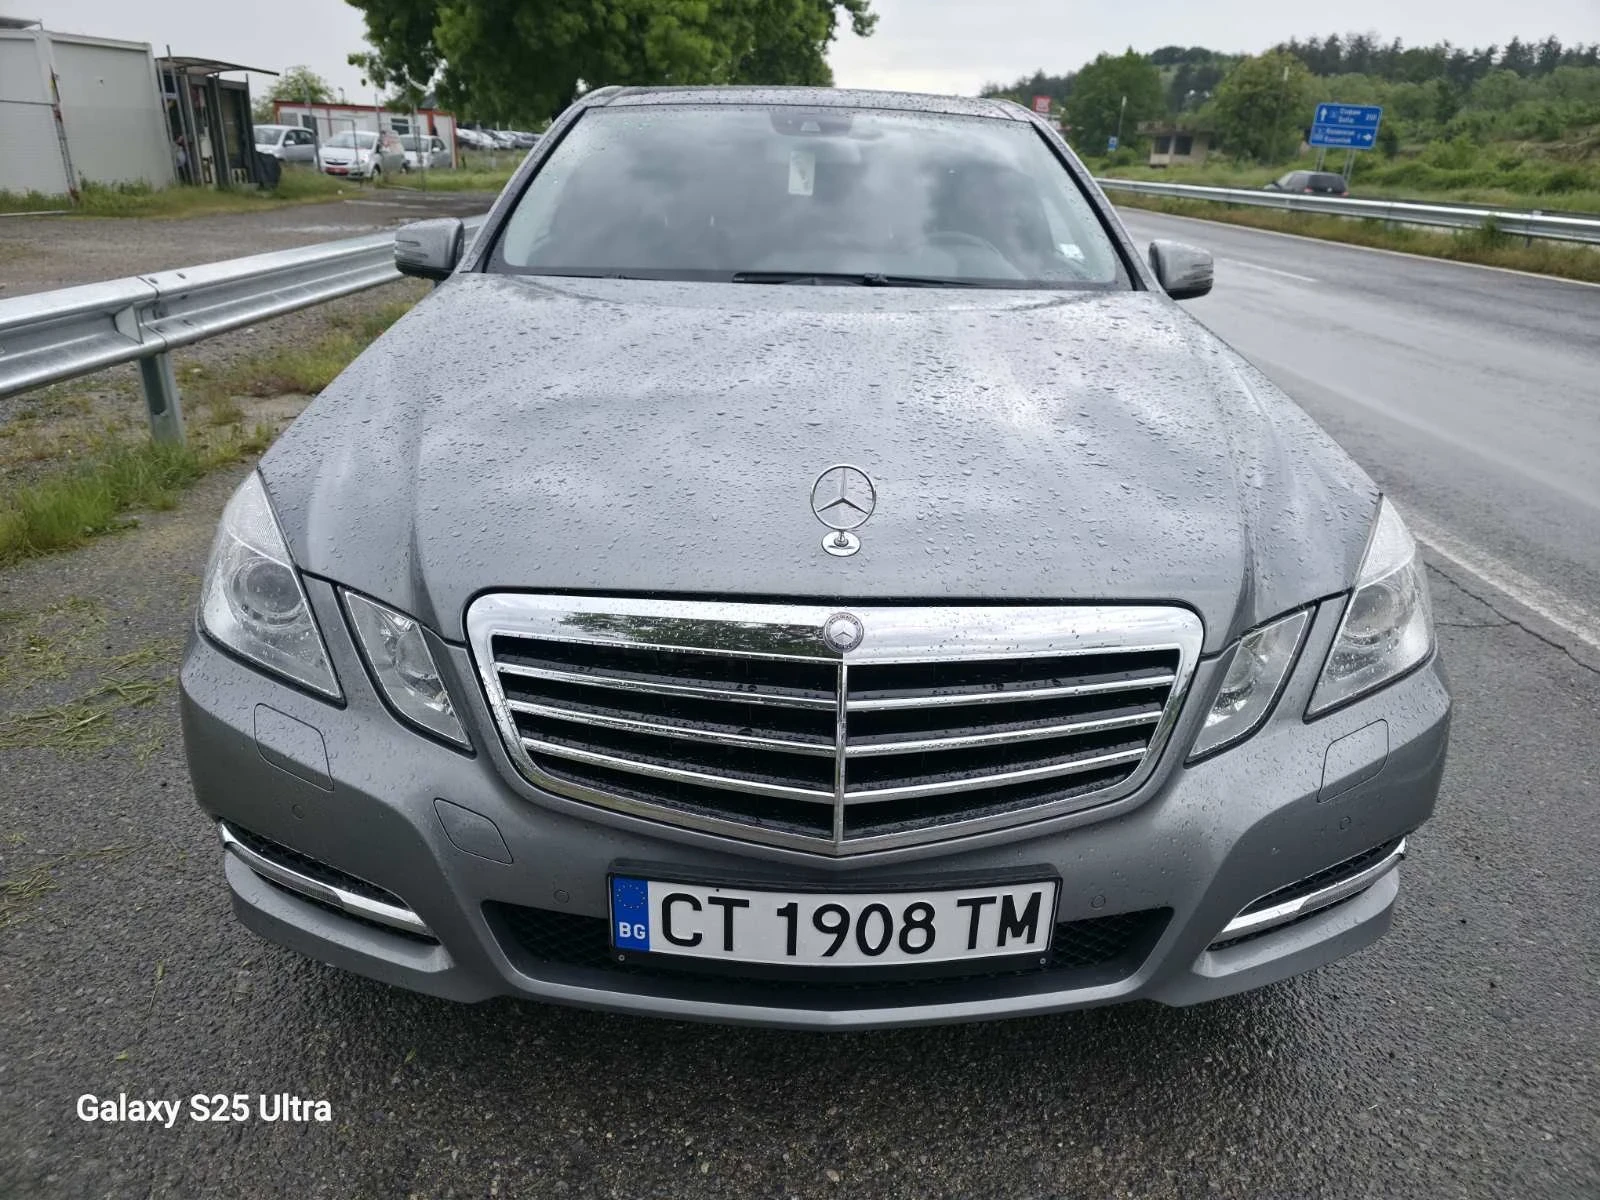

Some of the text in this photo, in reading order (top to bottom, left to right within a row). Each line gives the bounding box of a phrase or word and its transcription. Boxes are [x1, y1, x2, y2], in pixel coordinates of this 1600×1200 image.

[618, 921, 646, 940] BG
[661, 891, 1042, 957] CT 1908 TM
